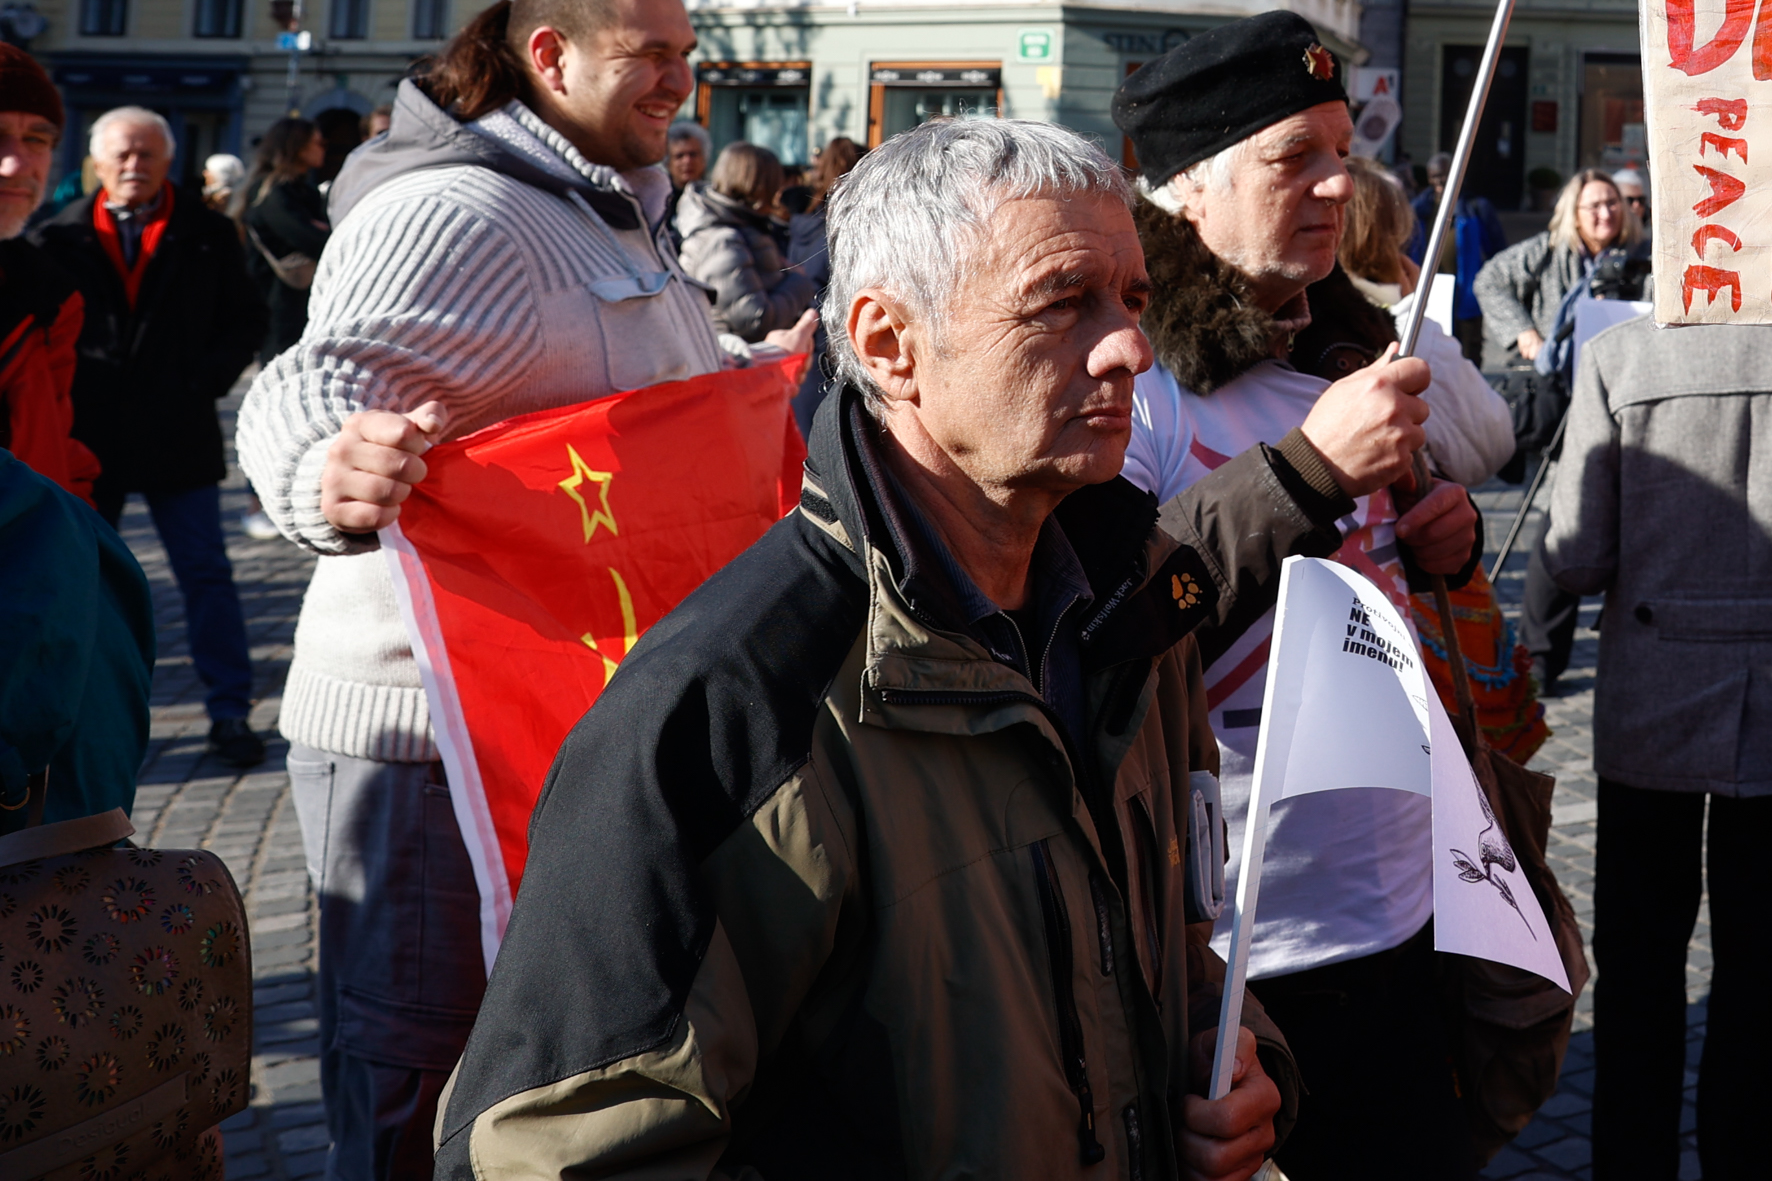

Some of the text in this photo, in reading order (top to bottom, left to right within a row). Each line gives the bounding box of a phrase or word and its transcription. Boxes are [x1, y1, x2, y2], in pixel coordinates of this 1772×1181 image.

[1680, 96, 1749, 317] PEACE
[1086, 577, 1133, 632] Jack Wolfskin
[1349, 606, 1371, 627] NE
[1342, 637, 1404, 673] imenu!
[1359, 628, 1414, 669] mojem
